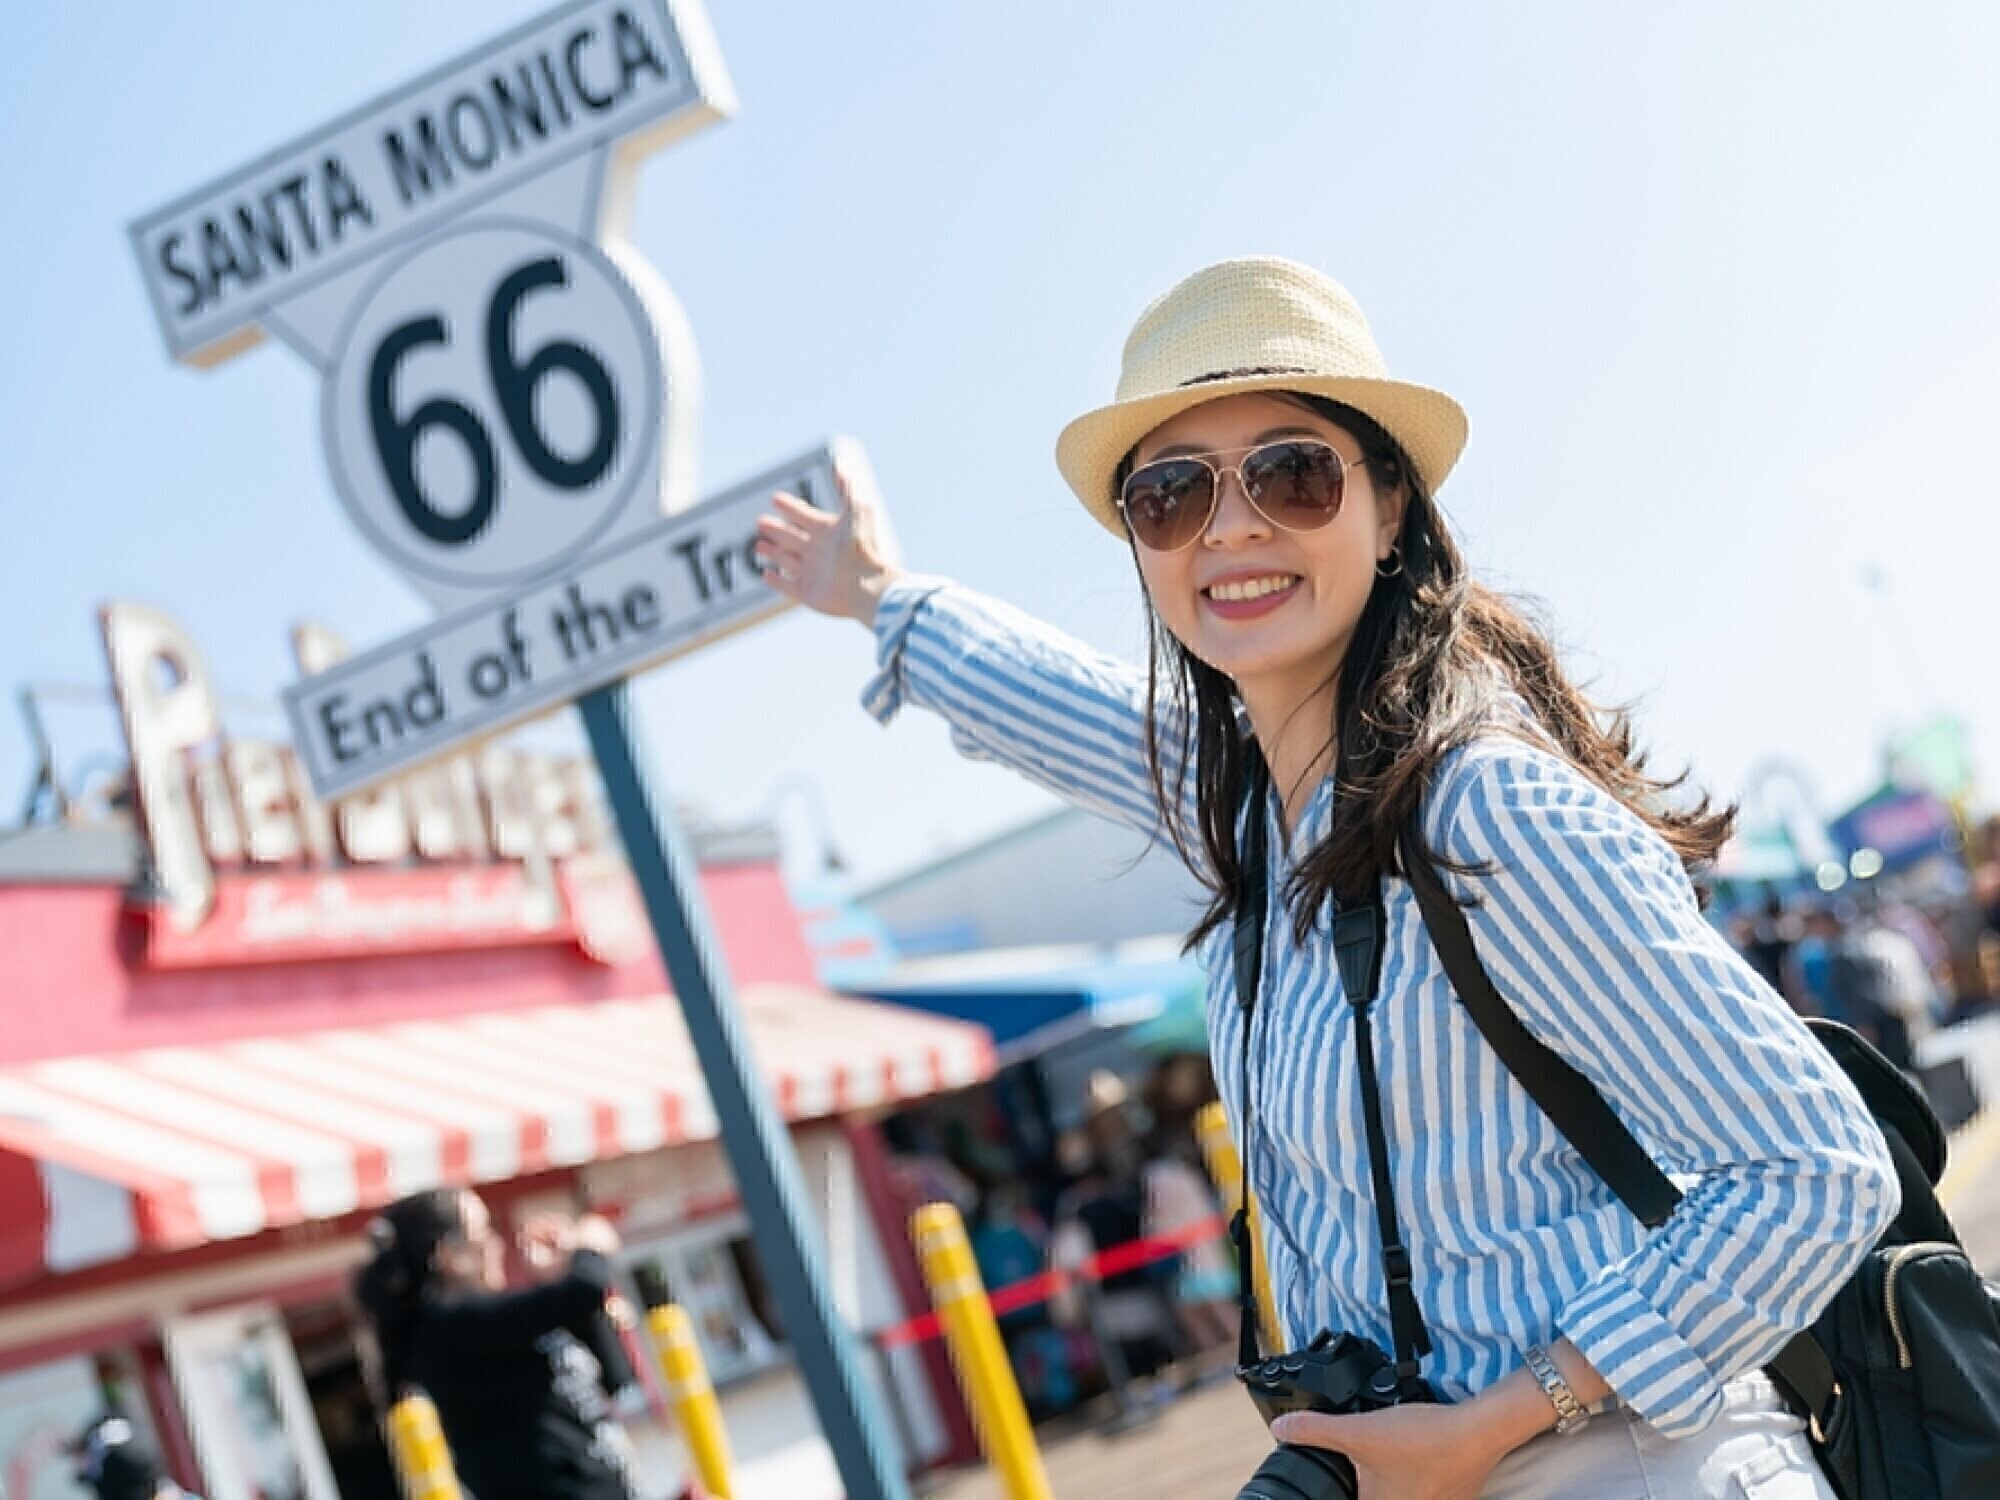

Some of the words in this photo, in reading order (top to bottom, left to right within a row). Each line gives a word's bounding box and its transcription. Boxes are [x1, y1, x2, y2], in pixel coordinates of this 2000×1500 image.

[159, 157, 372, 314] SANTA
[383, 10, 667, 204] MONICA
[370, 256, 621, 547] 66
[317, 652, 445, 765] End
[468, 613, 530, 699] of
[552, 586, 659, 661] the
